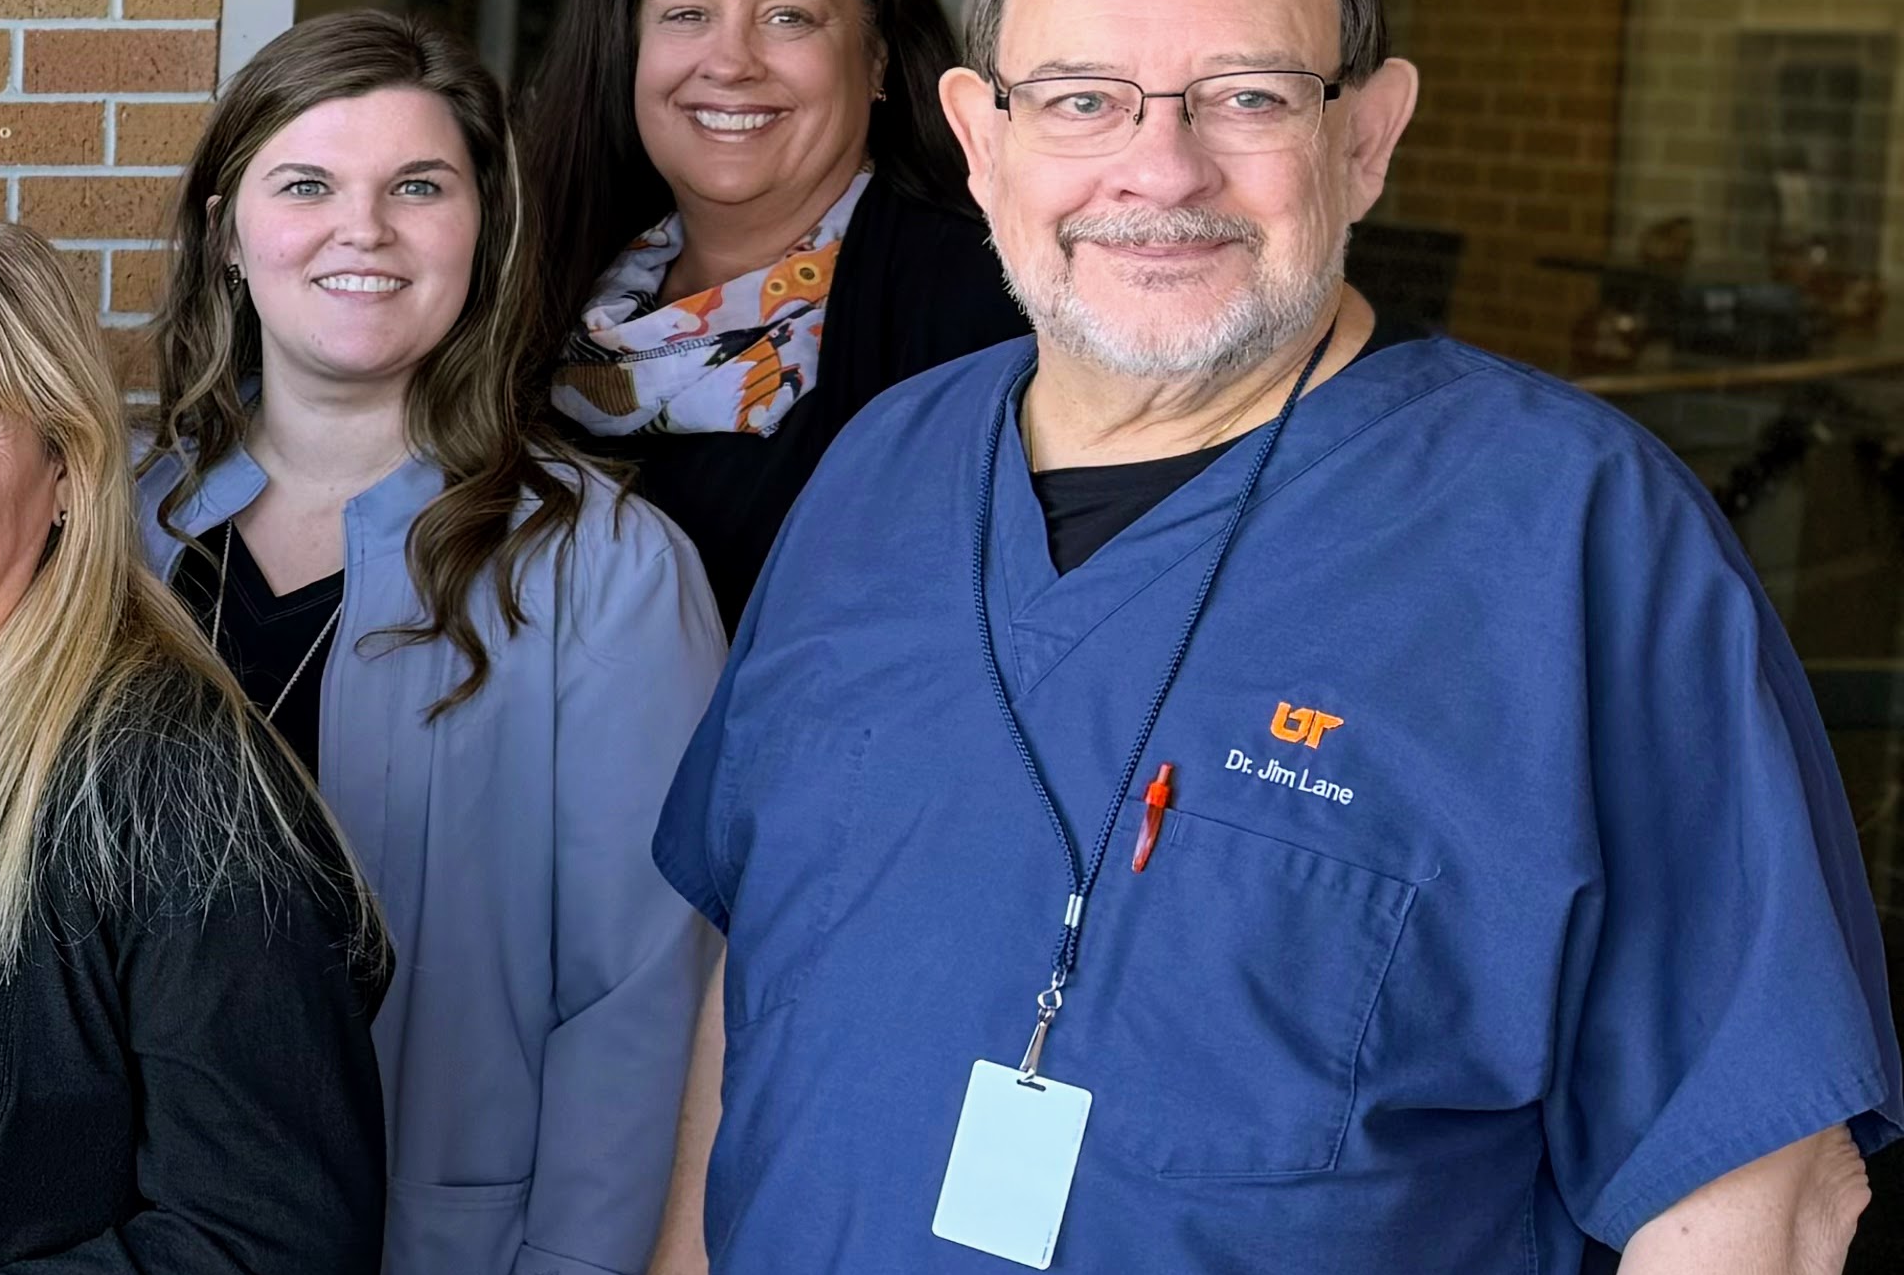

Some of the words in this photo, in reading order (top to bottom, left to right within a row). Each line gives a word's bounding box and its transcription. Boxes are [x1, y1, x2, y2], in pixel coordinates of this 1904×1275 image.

[1225, 749, 1252, 774] Dr.
[1257, 759, 1296, 788] Jim
[1298, 768, 1354, 805] Lane
